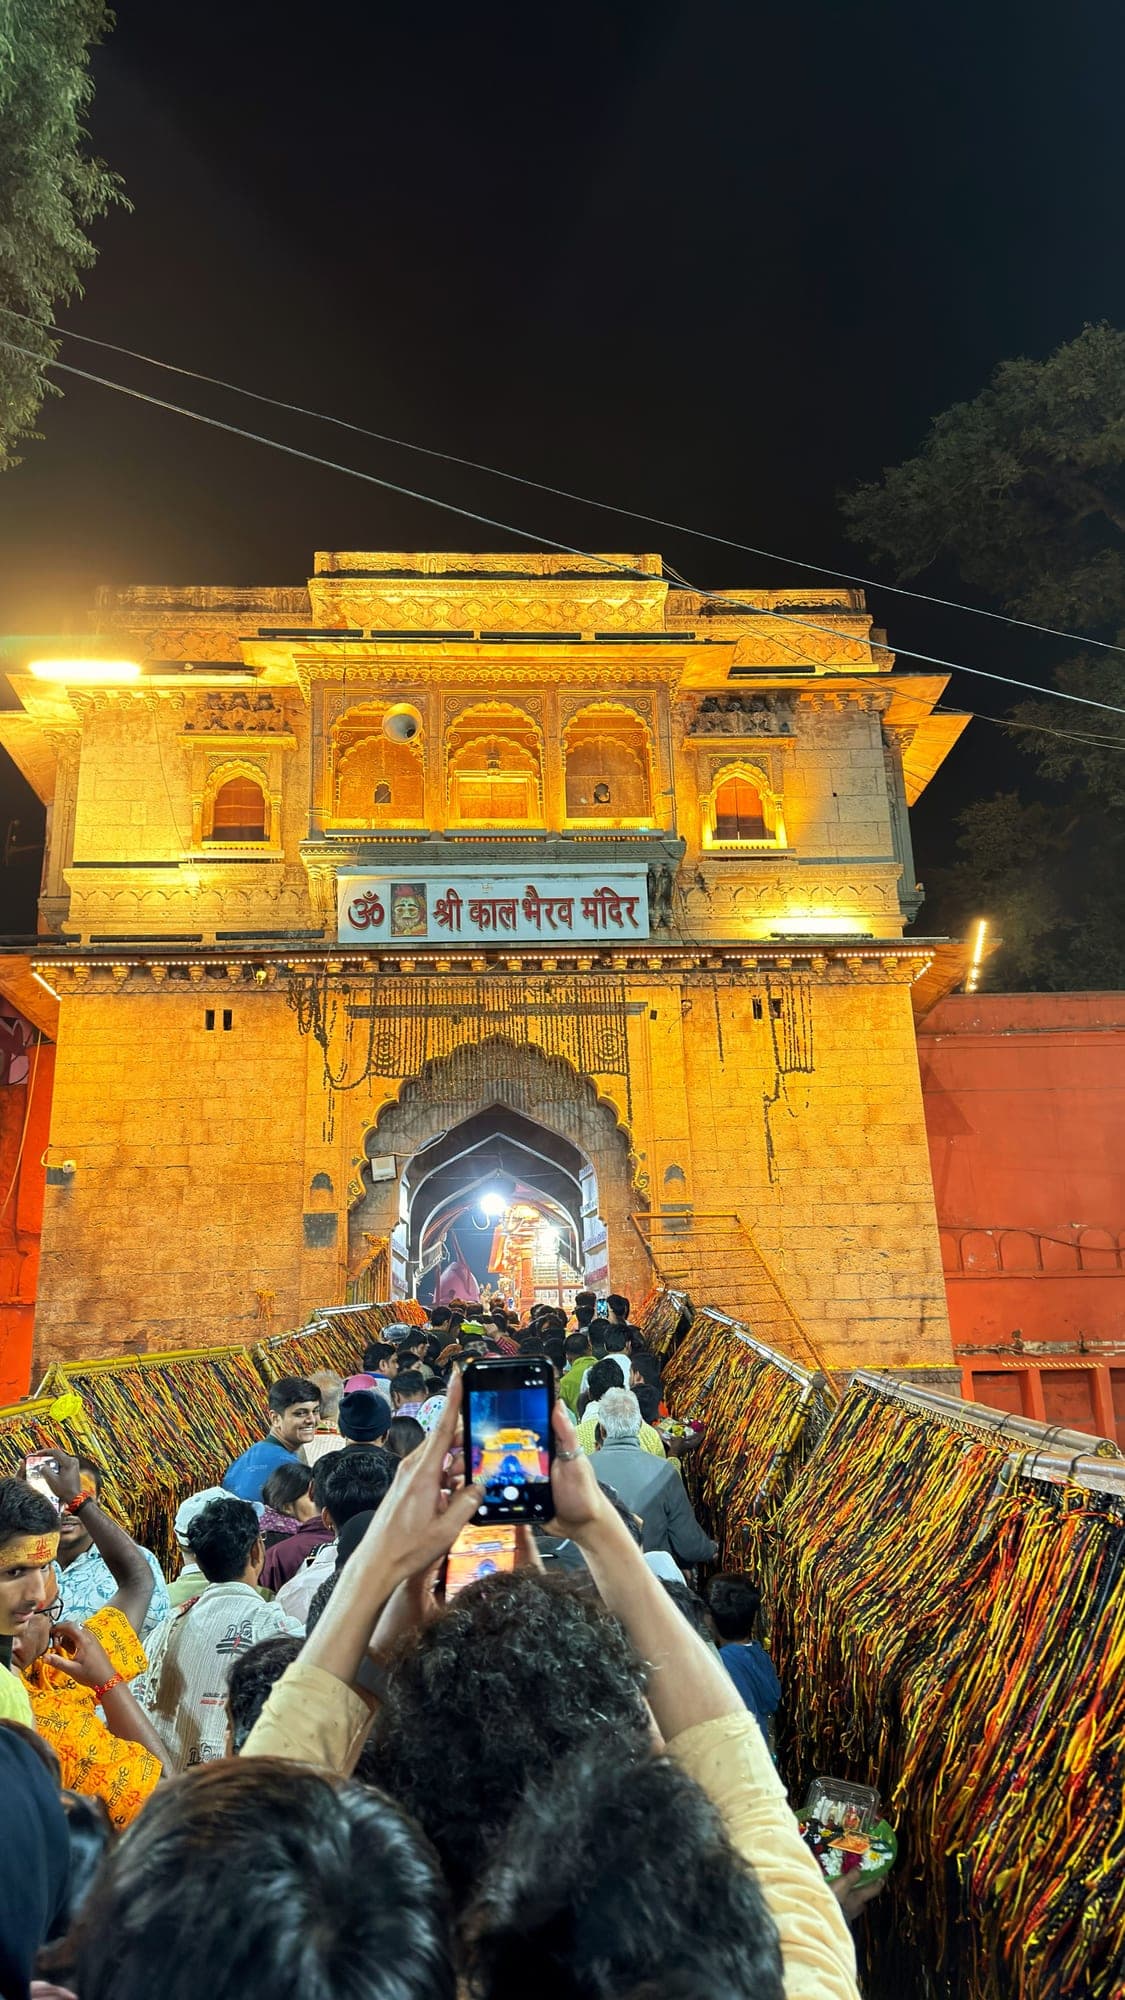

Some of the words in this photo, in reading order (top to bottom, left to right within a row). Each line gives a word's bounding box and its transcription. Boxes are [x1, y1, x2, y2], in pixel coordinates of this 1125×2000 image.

[433, 888, 463, 931] श्री
[468, 897, 519, 931] काल
[522, 885, 575, 930] भैरव
[581, 886, 640, 929] मंदिर
